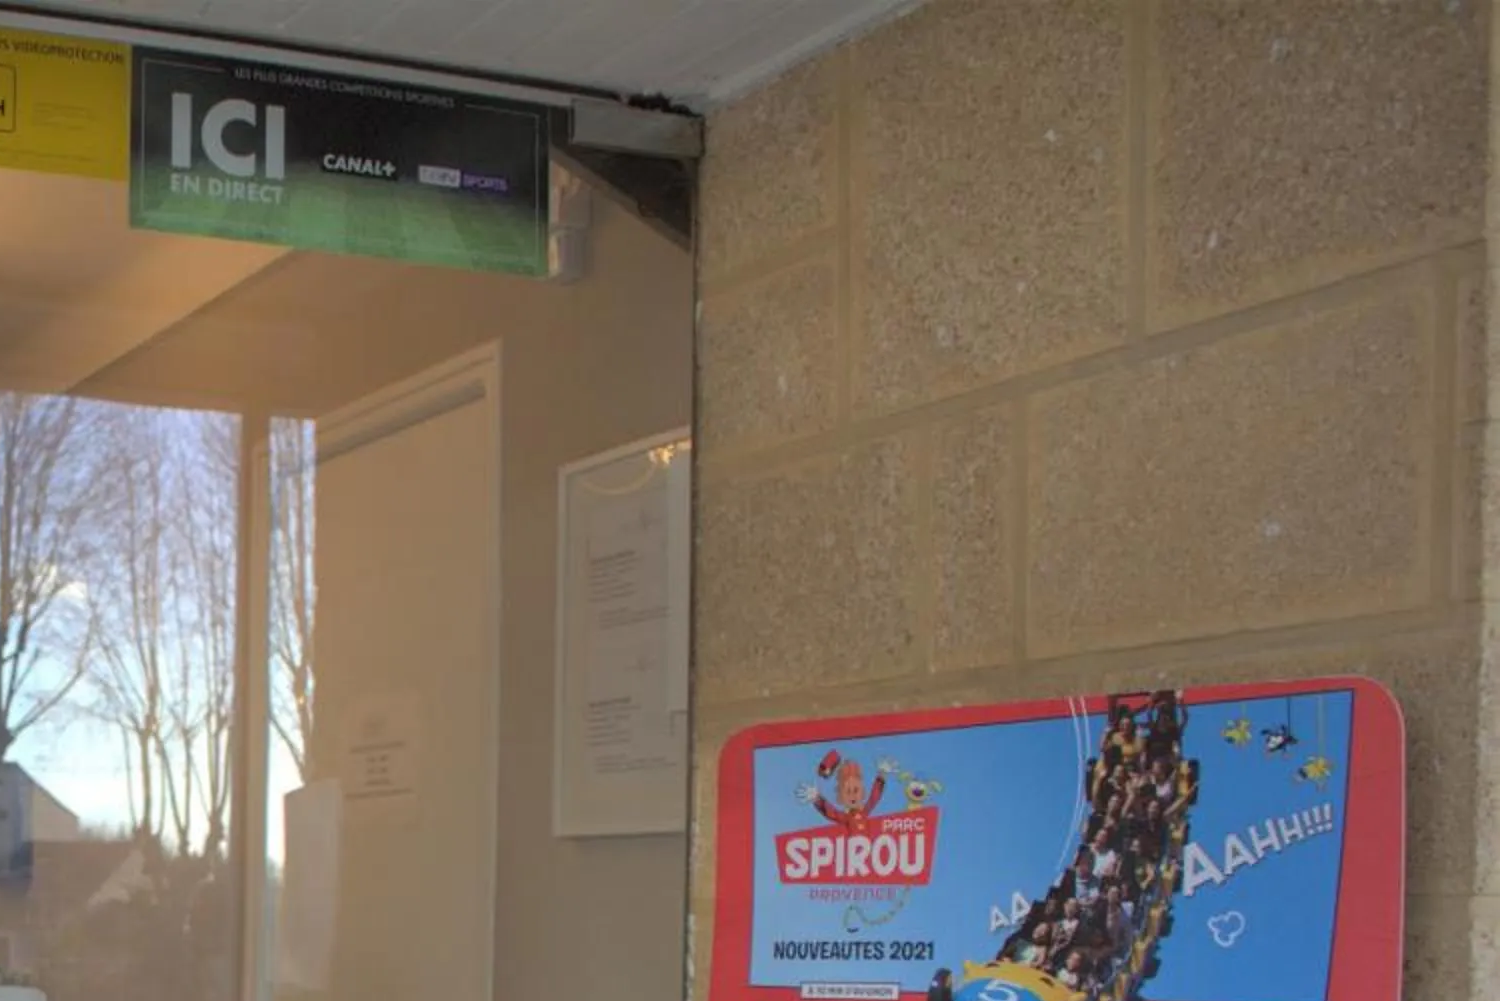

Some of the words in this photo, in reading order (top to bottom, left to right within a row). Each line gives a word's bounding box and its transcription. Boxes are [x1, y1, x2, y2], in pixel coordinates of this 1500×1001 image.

[171, 92, 286, 180] ICI
[322, 153, 397, 178] CANAL+
[170, 172, 200, 195] EN
[207, 175, 285, 204] DIRECT
[883, 817, 926, 833] PARC
[784, 833, 926, 879] SPIROU
[773, 940, 885, 961] NOUVEAUTES
[889, 940, 935, 961] 2021
